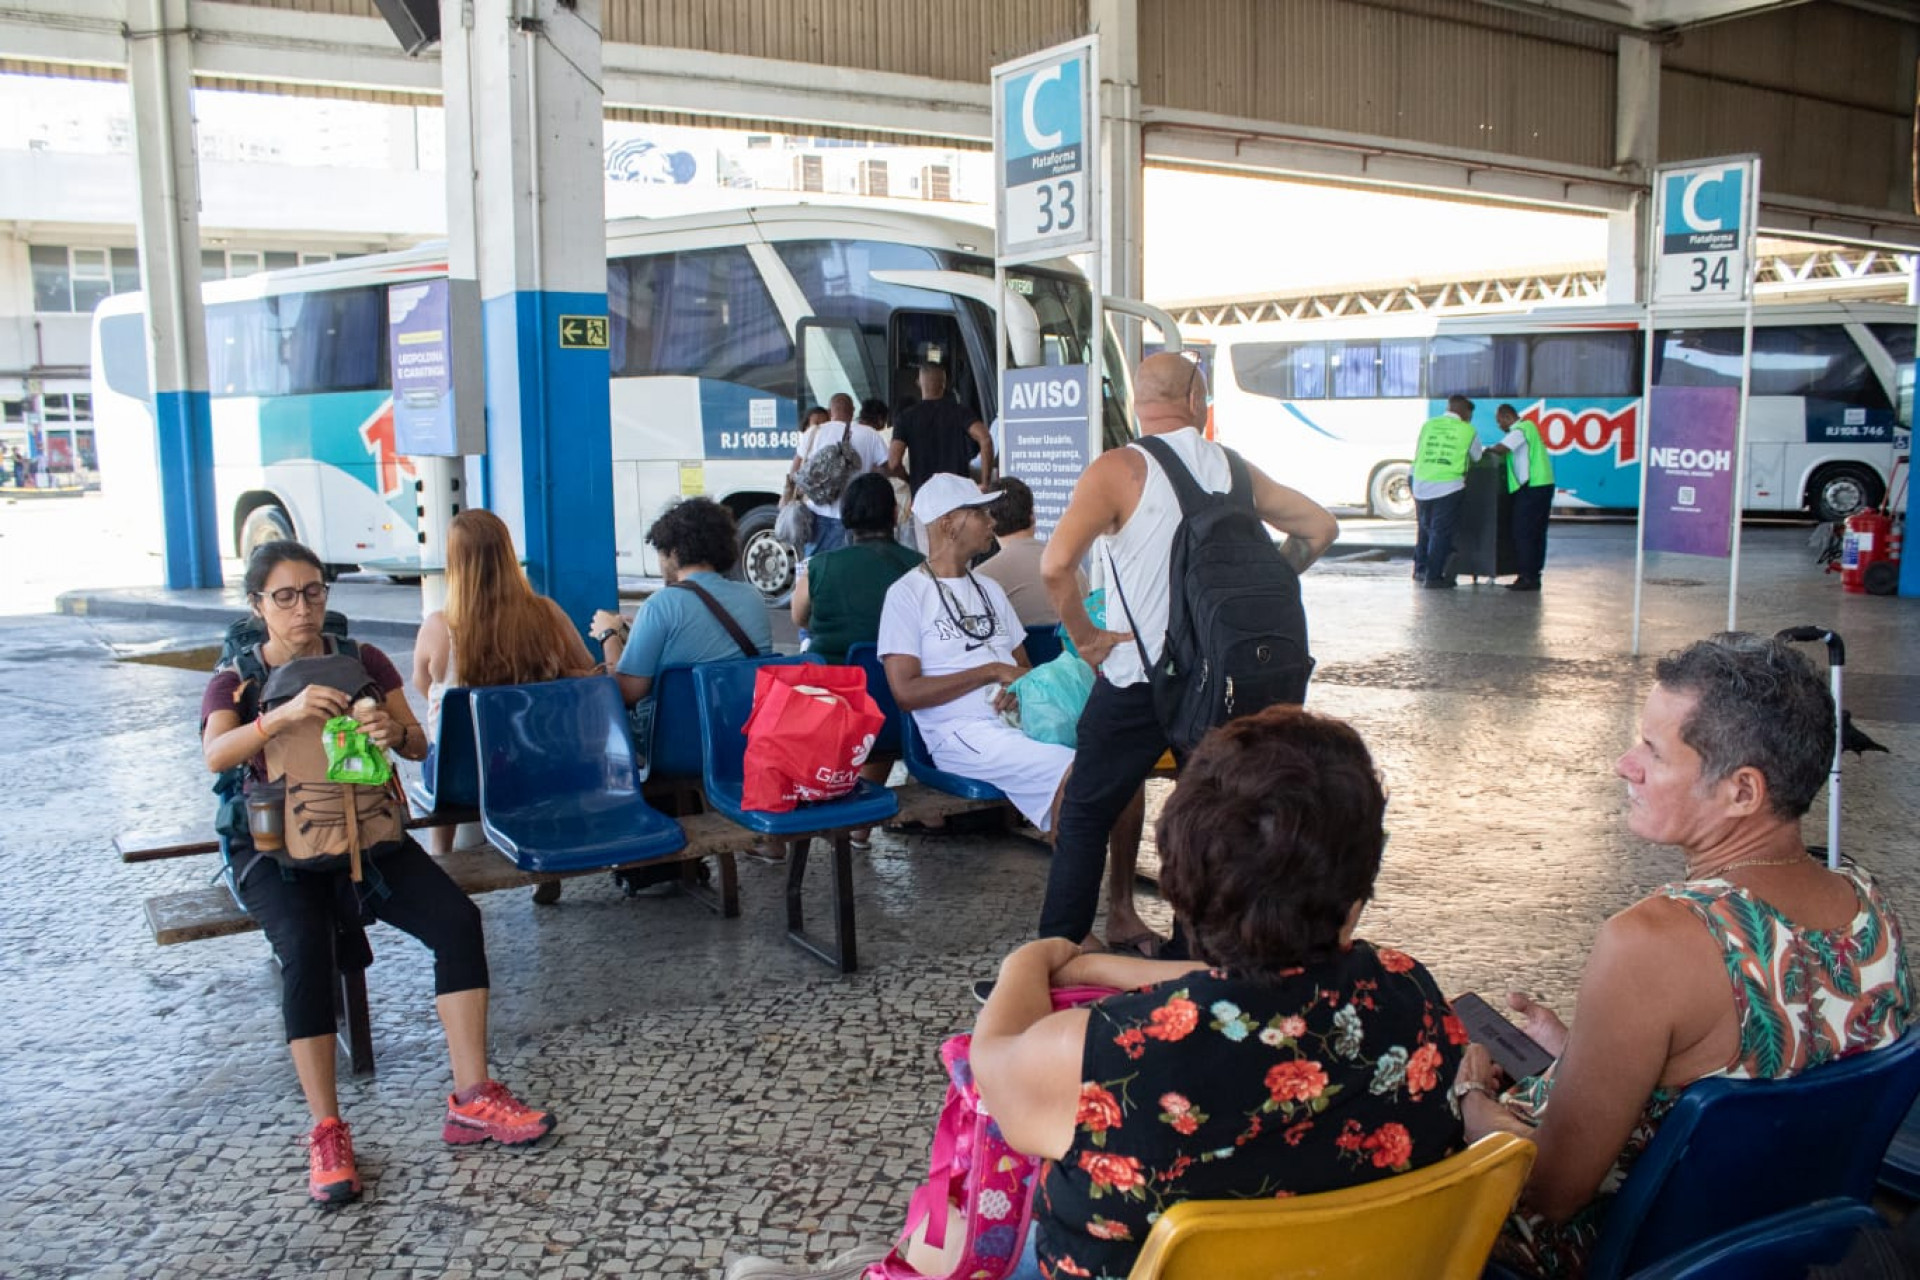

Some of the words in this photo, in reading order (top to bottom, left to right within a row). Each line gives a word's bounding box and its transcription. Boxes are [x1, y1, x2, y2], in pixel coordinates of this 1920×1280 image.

[1022, 65, 1062, 150] C
[1032, 150, 1076, 169] Plataforma
[1036, 180, 1075, 234] 33
[1682, 168, 1724, 232] C
[1689, 233, 1734, 245] Plataforma
[1689, 256, 1730, 293] 34
[1010, 379, 1080, 410] AVISO
[720, 432, 740, 449] RJ
[1016, 462, 1051, 472] PROIBIDO
[1649, 447, 1731, 471] NEOOH
